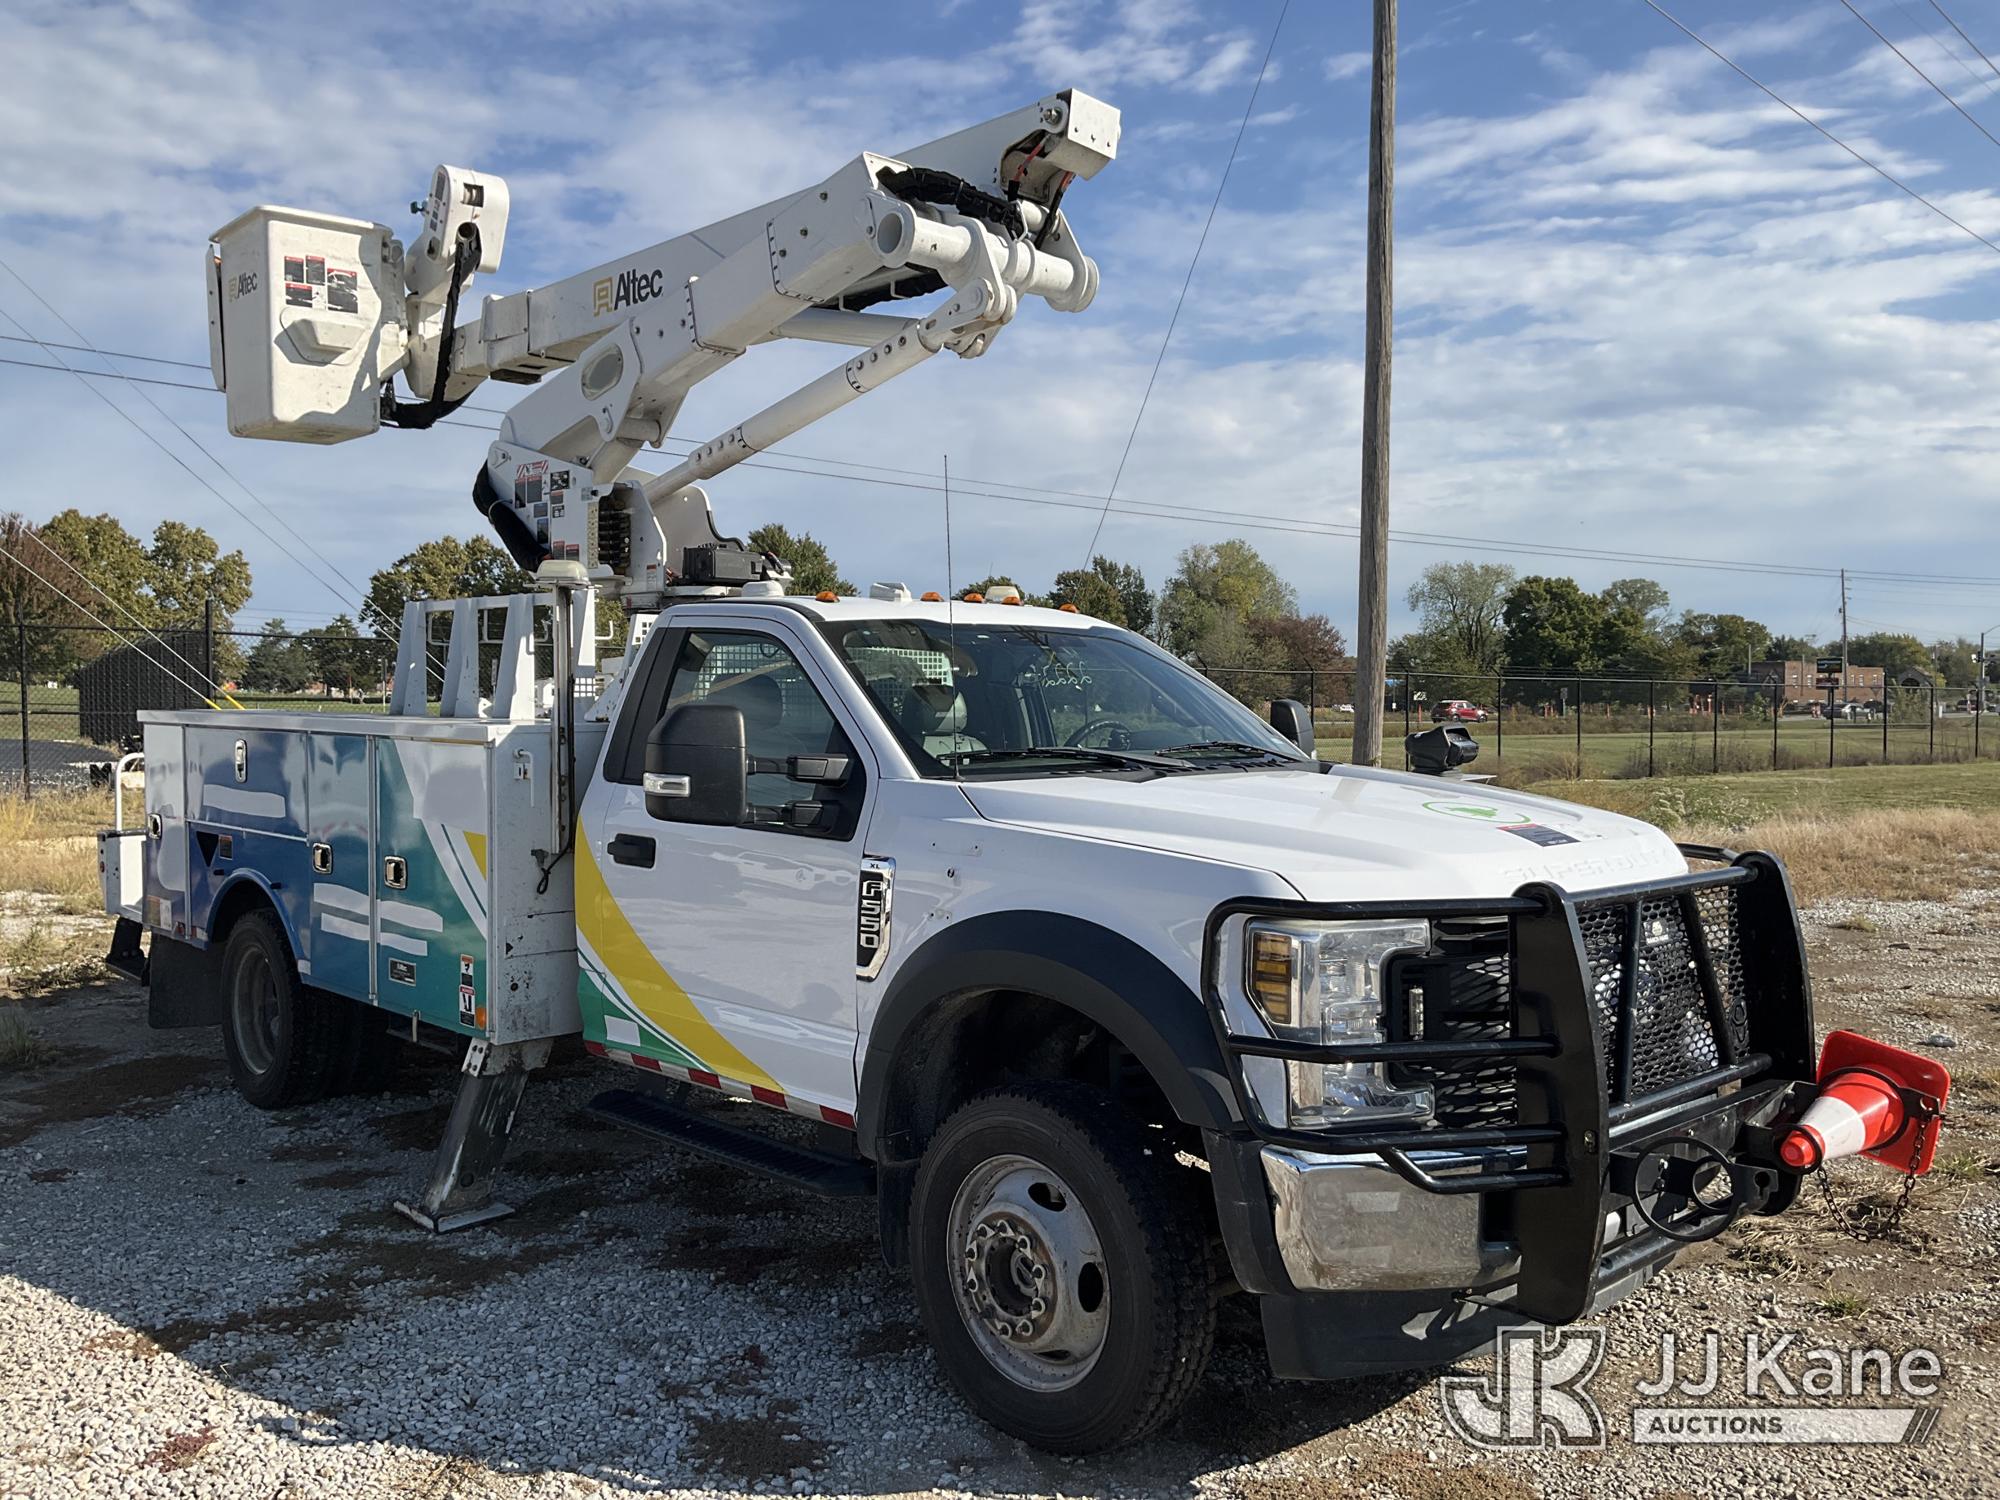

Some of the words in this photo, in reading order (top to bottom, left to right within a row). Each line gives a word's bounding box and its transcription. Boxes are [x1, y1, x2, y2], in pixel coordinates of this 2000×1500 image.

[237, 271, 258, 300] Altec
[614, 269, 664, 311] Altec
[860, 880, 882, 949] F550
